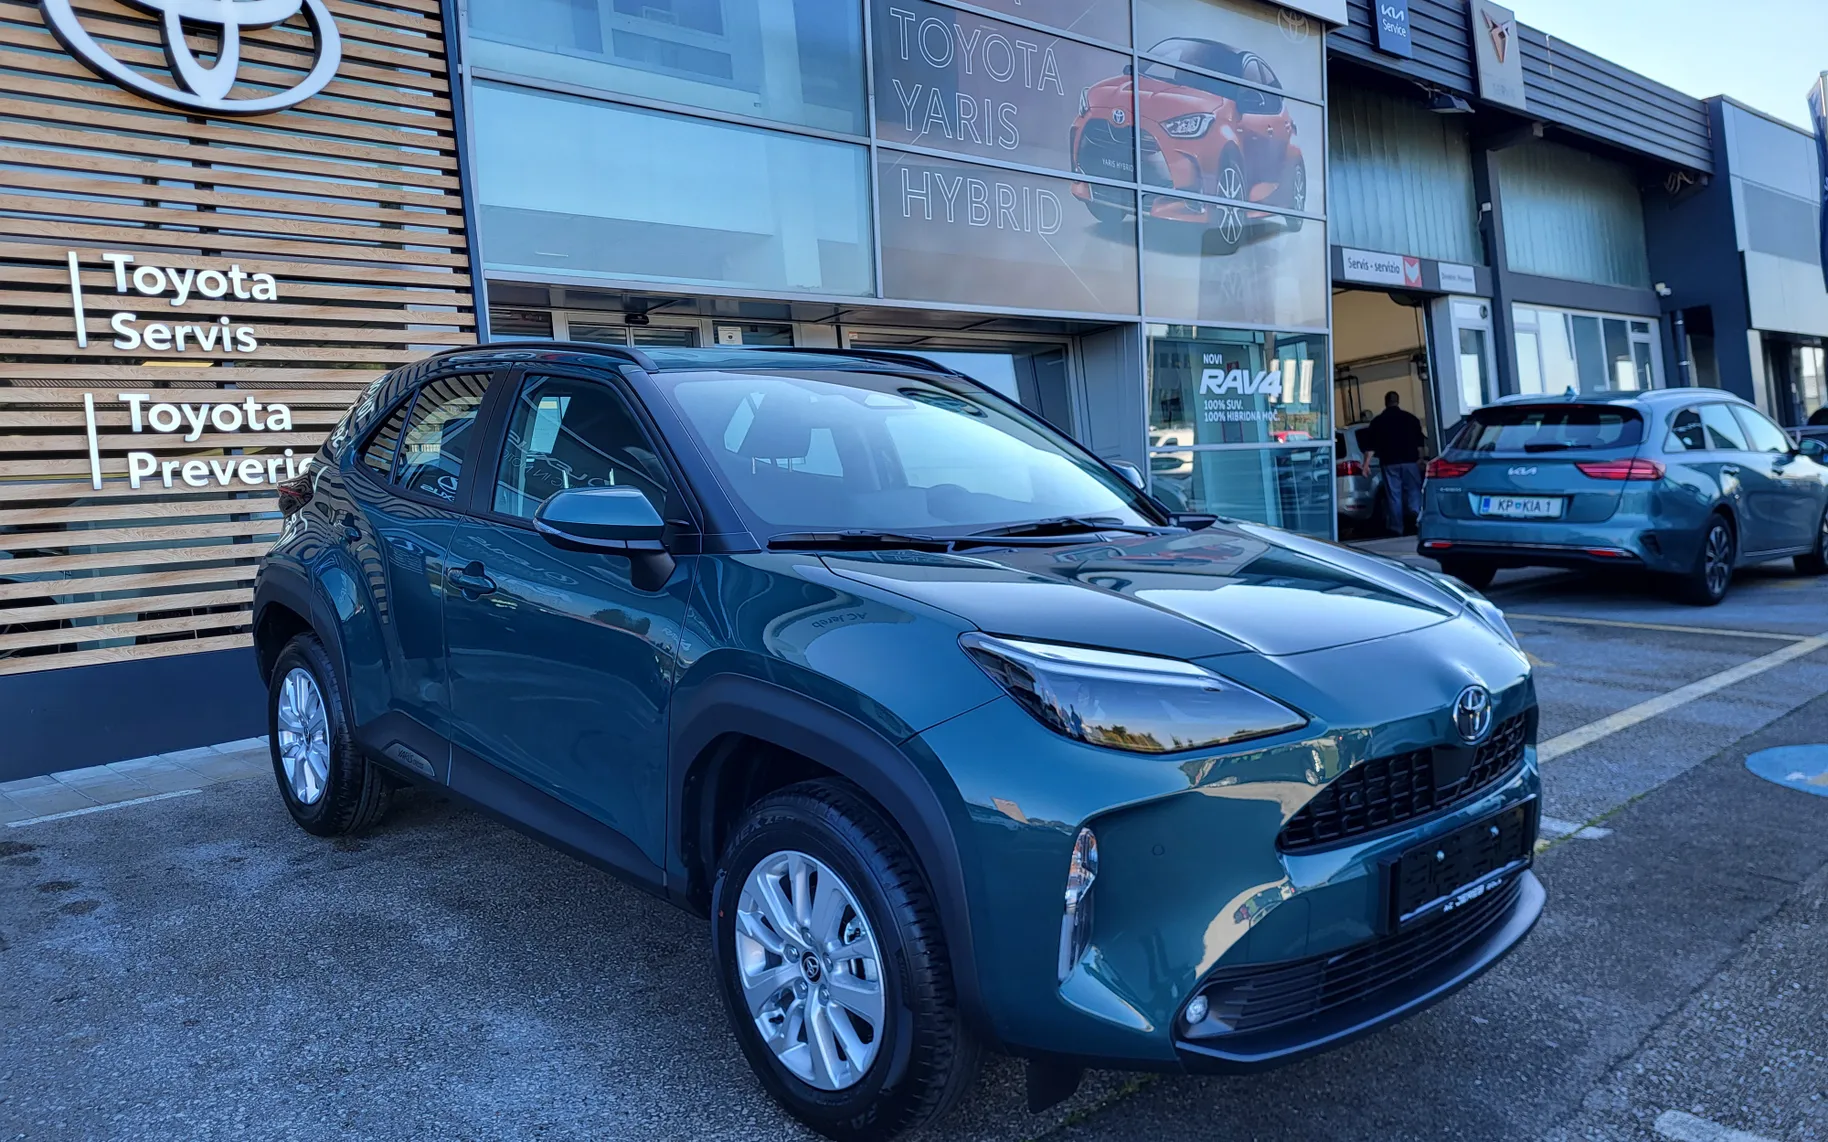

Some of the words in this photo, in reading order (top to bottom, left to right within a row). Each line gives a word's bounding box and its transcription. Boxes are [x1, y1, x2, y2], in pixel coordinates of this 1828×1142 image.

[1382, 19, 1407, 38] Service
[889, 7, 1065, 96] TOYOTA
[892, 79, 1020, 150] YARIS
[901, 168, 1063, 235] HYBRID
[102, 253, 278, 307] Toyota
[1347, 256, 1369, 271] Servis
[1374, 261, 1401, 275] servizio
[110, 312, 258, 353] Servis
[1203, 353, 1223, 365] NOVI
[1200, 368, 1283, 397] RAV4
[118, 393, 293, 442] Toyota
[1204, 399, 1226, 410] 100%
[1226, 399, 1244, 410] SUV.
[1204, 411, 1226, 422] 100%
[1226, 410, 1261, 422] HIBRIDNA
[1498, 499, 1513, 512] KP
